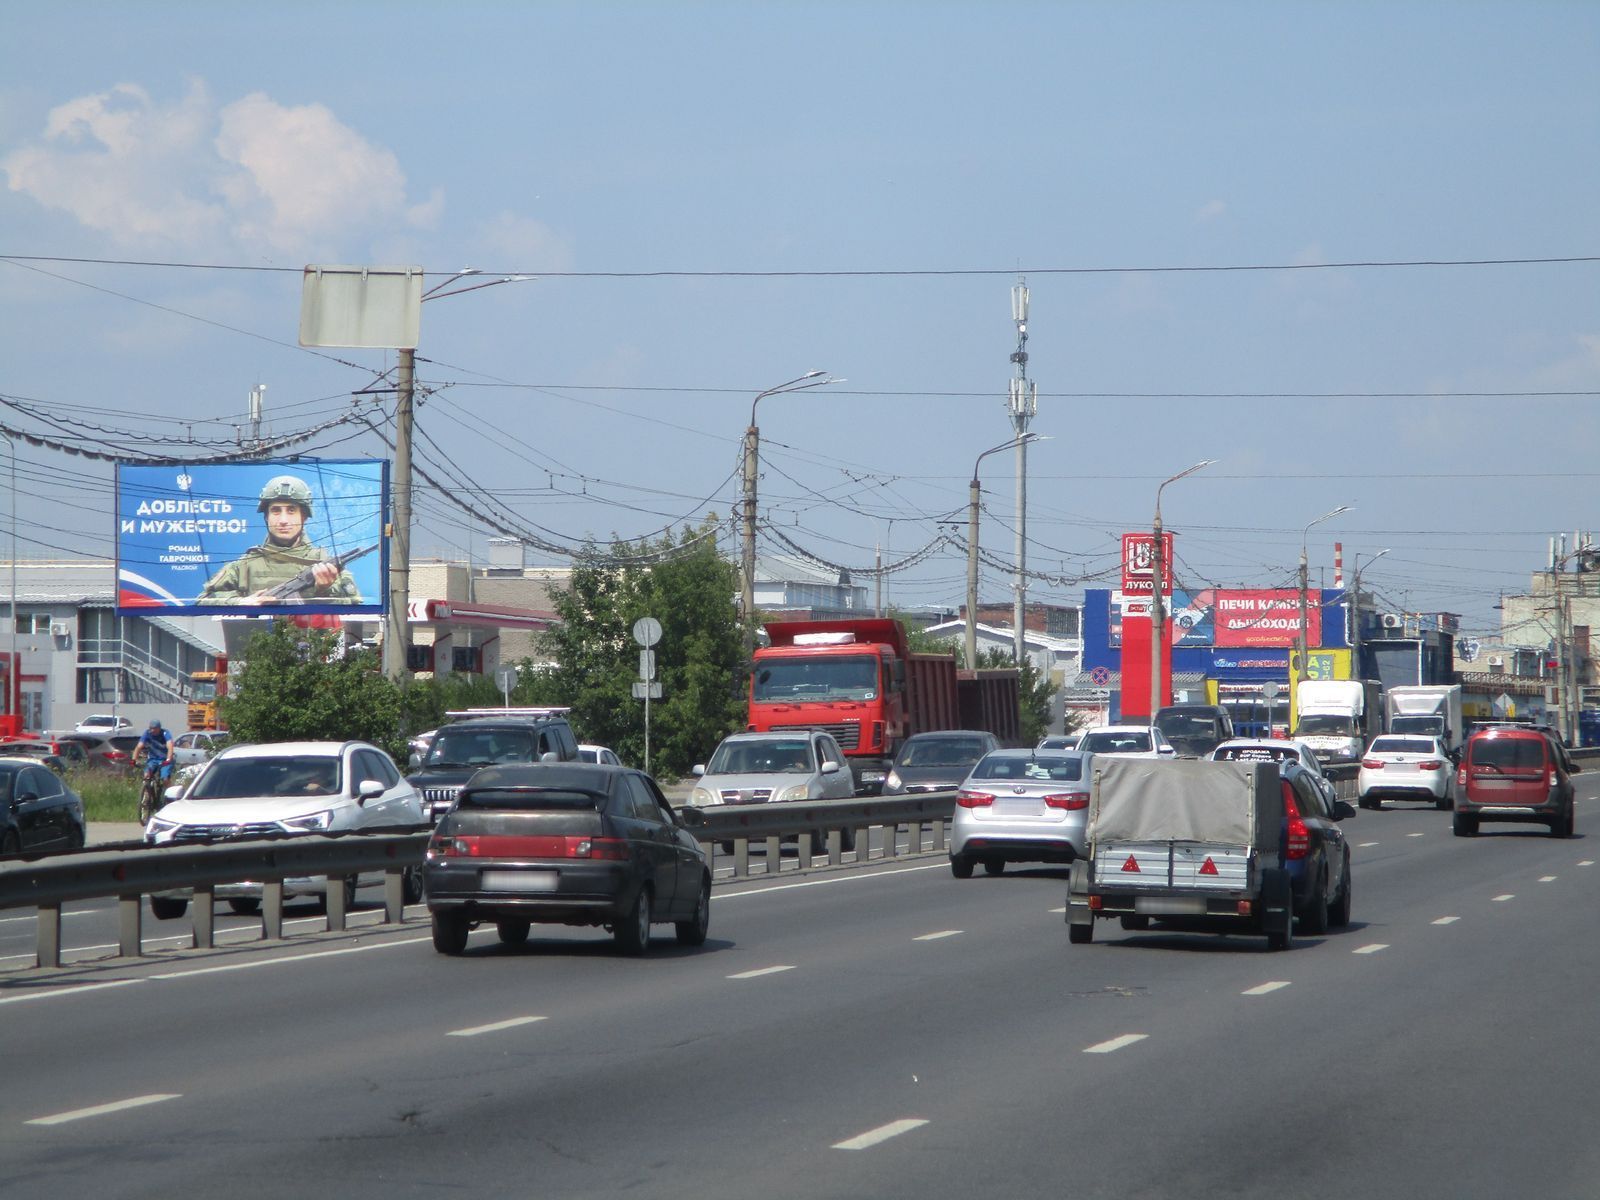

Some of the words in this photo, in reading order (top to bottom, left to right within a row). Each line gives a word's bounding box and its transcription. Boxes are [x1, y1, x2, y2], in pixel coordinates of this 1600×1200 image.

[136, 499, 232, 515] ДОБЛЕСТЬ
[121, 519, 135, 533] И
[140, 518, 247, 533] МУЖЕСТВО!
[168, 544, 201, 553] РОМАН
[1125, 580, 1168, 589] ЛУКОЛ
[1219, 599, 1252, 610] ПЕЧИ
